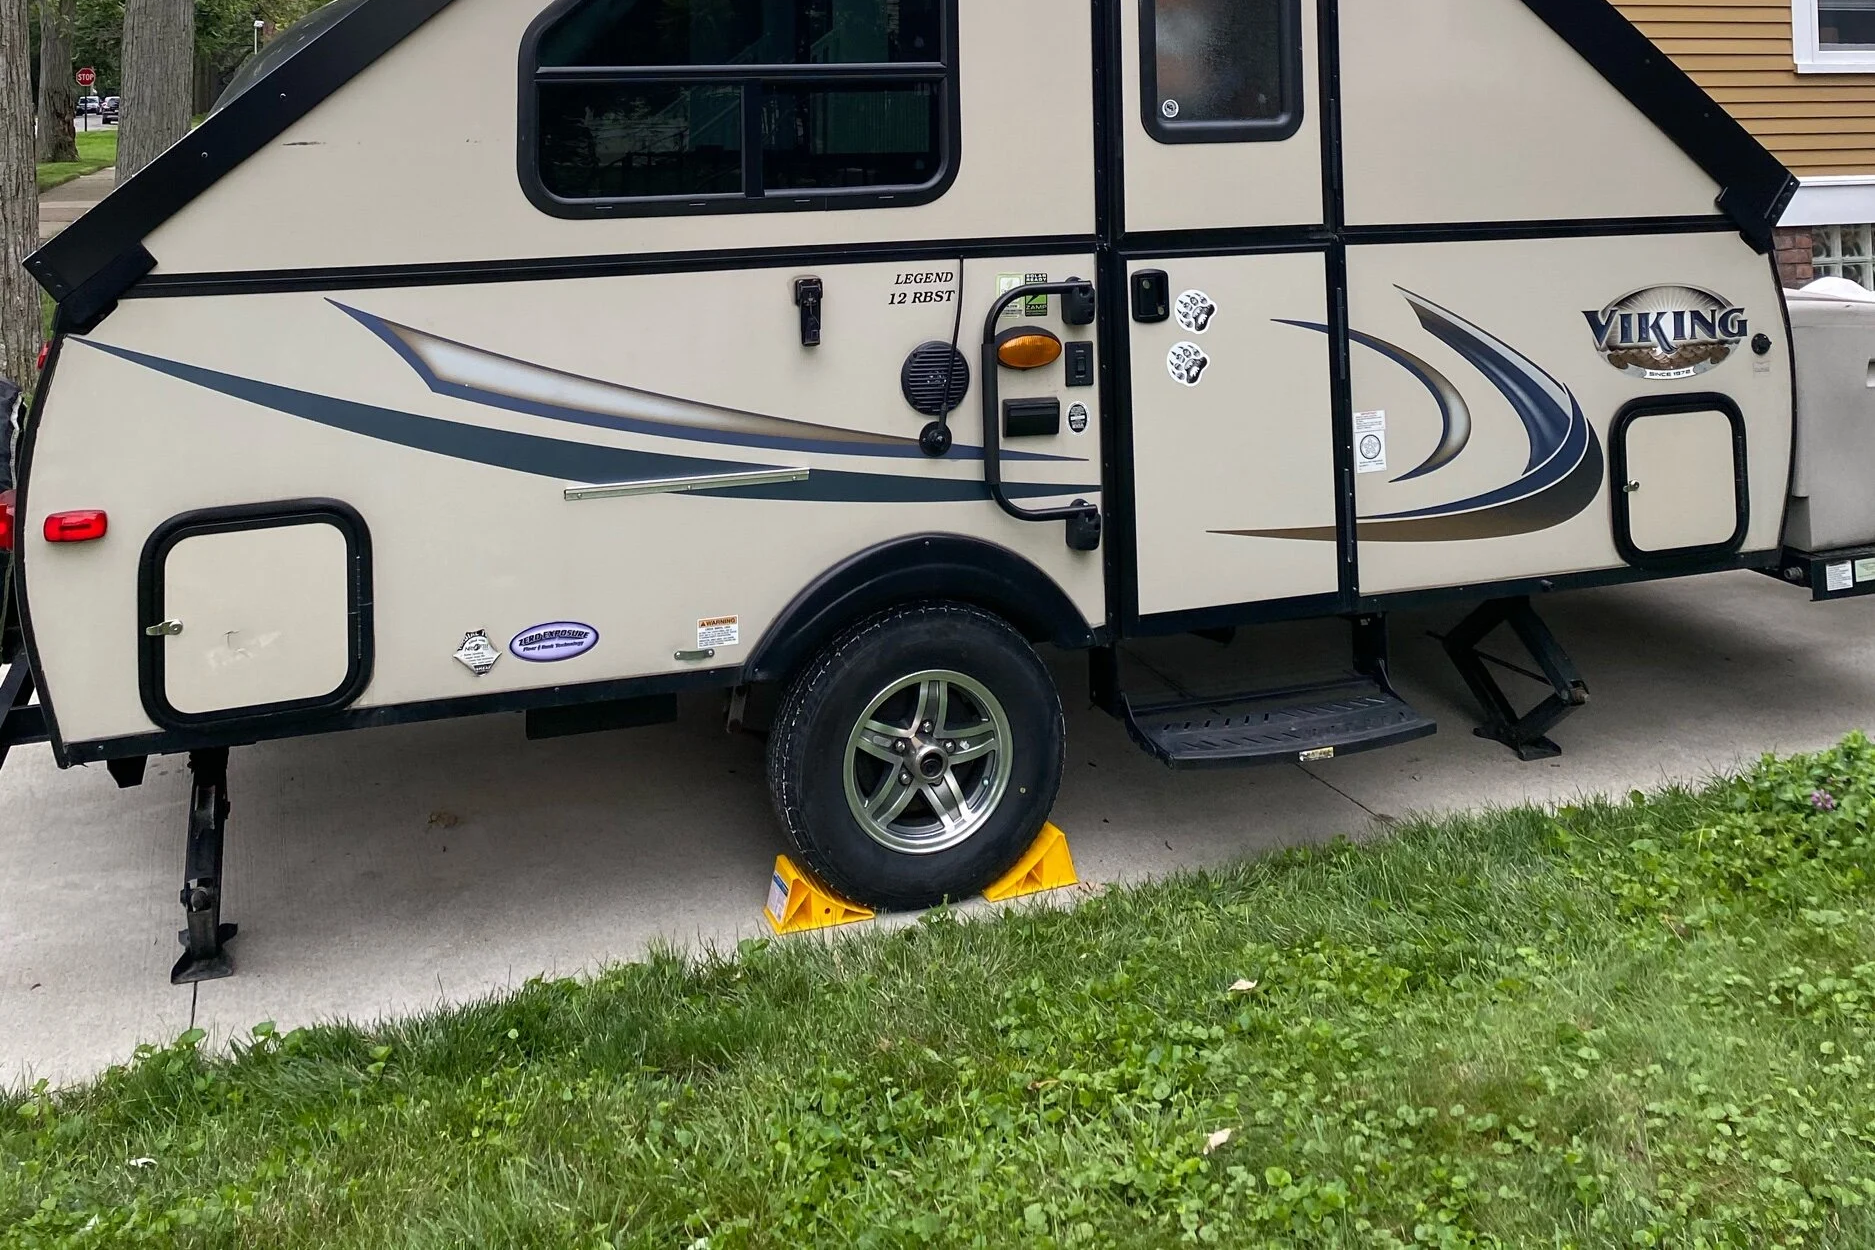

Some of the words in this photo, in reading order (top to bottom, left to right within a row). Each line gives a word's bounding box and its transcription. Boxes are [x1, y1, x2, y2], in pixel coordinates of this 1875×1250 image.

[894, 272, 954, 285] LEGEND
[888, 292, 908, 305] 12
[911, 290, 956, 304] RBST
[1581, 307, 1748, 354] VIKING
[706, 617, 735, 626] WARNING
[518, 632, 542, 646] ZERO
[543, 629, 590, 639] EXPOSURE
